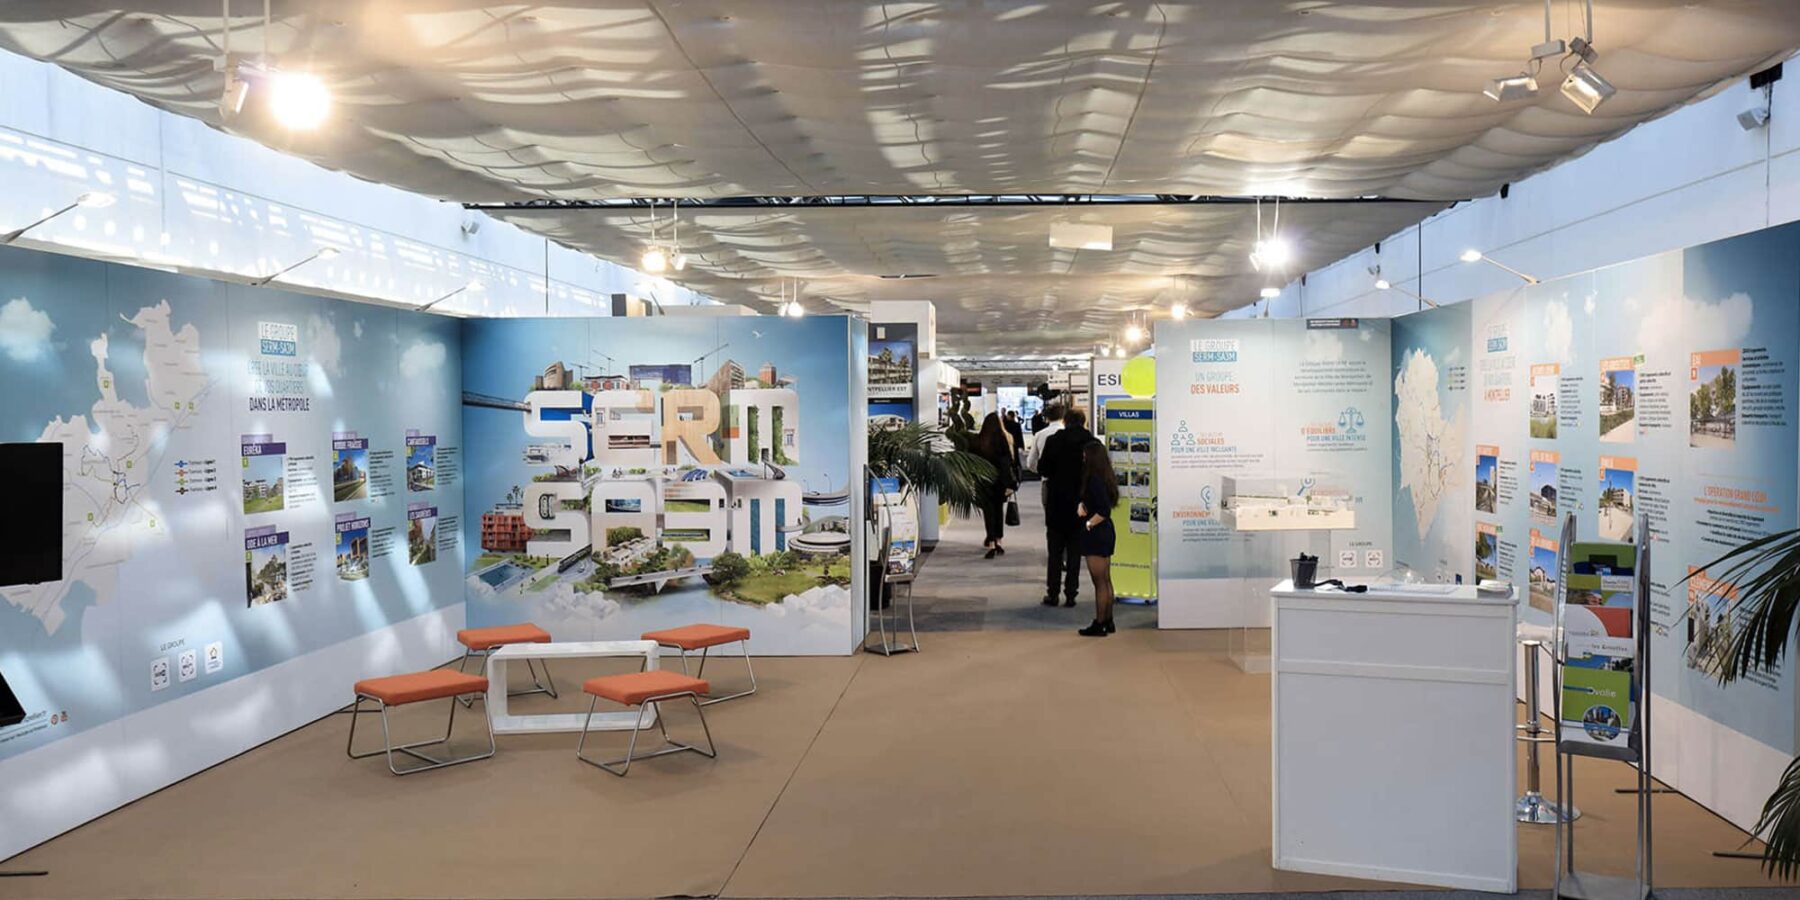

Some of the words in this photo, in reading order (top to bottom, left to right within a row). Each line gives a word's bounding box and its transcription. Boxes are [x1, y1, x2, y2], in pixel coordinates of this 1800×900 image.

[1191, 384, 1205, 394] DES
[1206, 384, 1239, 394] VALEURS
[249, 397, 266, 411] DANS
[268, 398, 275, 411] LA
[524, 389, 799, 466] SERM
